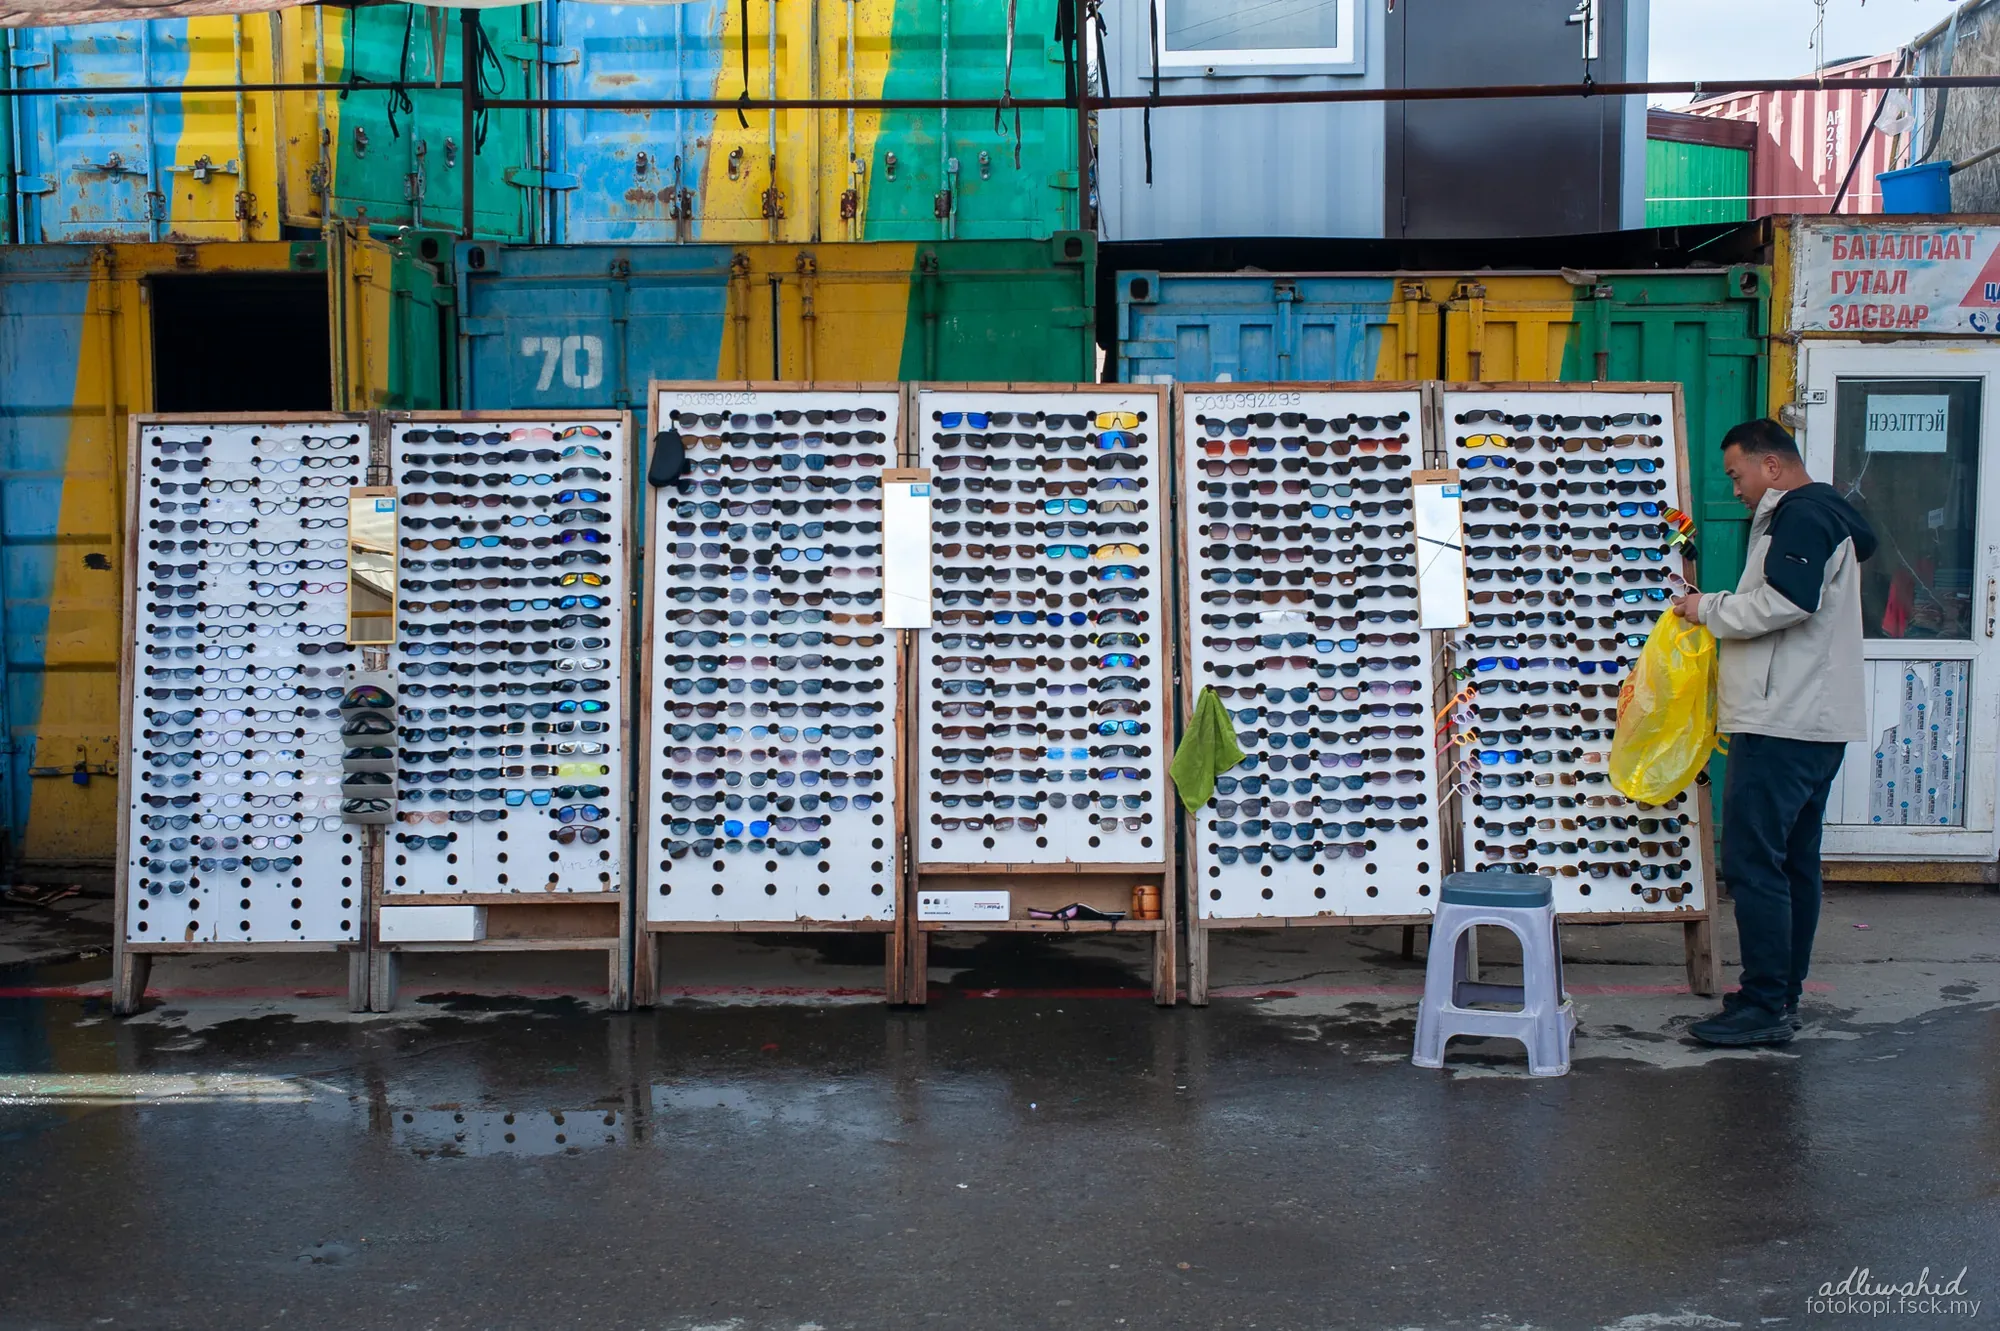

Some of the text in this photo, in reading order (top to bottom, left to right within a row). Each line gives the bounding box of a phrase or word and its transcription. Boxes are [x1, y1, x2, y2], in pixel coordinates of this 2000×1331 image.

[1832, 235, 1975, 261] БАТАЛГААТ
[1831, 270, 1908, 295] ГУТАЛ
[1829, 304, 1929, 330] ЗАСВАР
[521, 335, 603, 391] 70
[1868, 409, 1945, 432] НЭЭЛТТЭЙ
